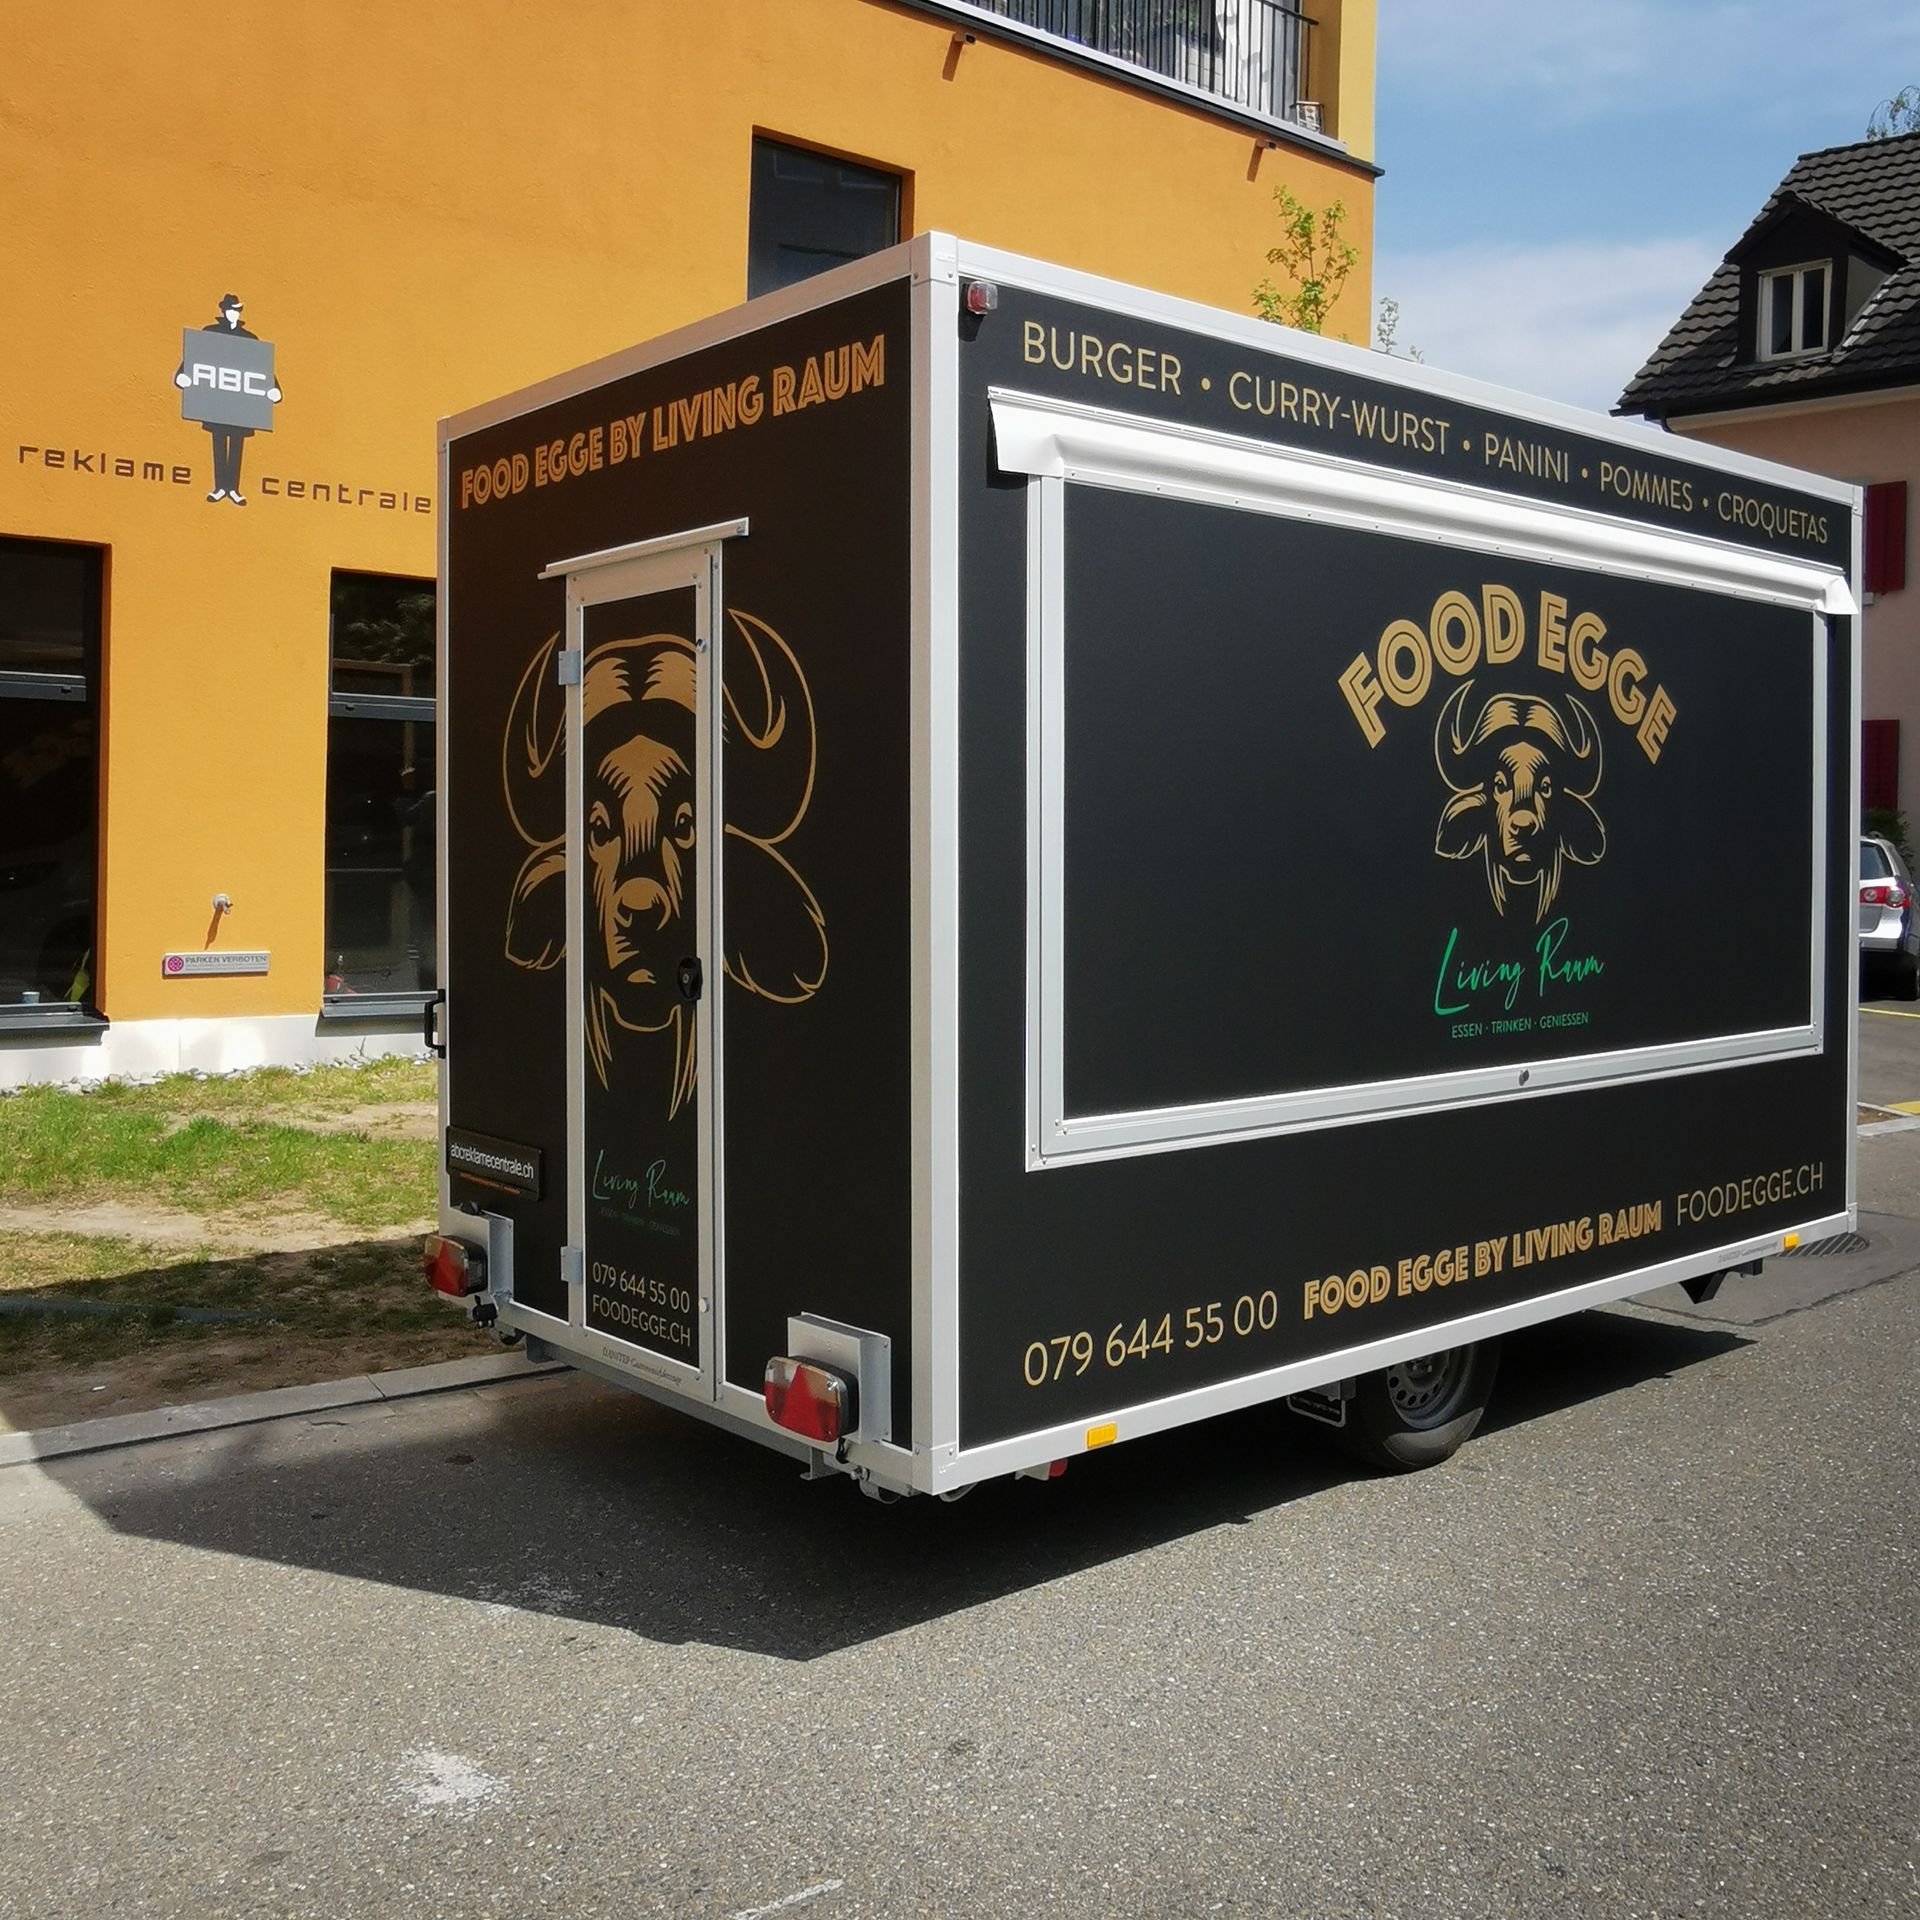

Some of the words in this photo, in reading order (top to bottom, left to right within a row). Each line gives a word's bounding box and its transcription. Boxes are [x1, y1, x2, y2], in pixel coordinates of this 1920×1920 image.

[193, 363, 267, 396] ABC
[462, 453, 530, 509] FOOD
[535, 426, 603, 487] EGGE
[609, 411, 646, 465] BY
[653, 375, 763, 452] LIVING
[772, 334, 885, 416] RAUM
[1023, 320, 1183, 395] BURGER
[1229, 371, 1450, 455] CURRY-WURST
[1485, 433, 1569, 483] PANINI
[1600, 461, 1694, 512] POMMES
[1718, 492, 1828, 544] CROQUETAS
[19, 445, 191, 485] reklame
[262, 476, 431, 514] centrale
[1338, 584, 1526, 749] FOOD
[1538, 590, 1677, 765] EGGE
[185, 956, 220, 964] PARKEN
[221, 955, 267, 963] VERBOTEN
[1435, 927, 1525, 1015] Living
[1536, 917, 1604, 997] Raum
[1452, 1022, 1483, 1039] ESSEN
[1491, 1017, 1532, 1034] TRINKEN
[1539, 1012, 1589, 1029] GENIESSEN
[592, 1148, 639, 1209] Living
[1676, 1161, 1824, 1227] FOODEGGE.CH
[592, 1262, 617, 1288] 079
[619, 1270, 646, 1299] 644
[649, 1279, 666, 1307] 55
[670, 1287, 690, 1314] 00
[1304, 1265, 1391, 1320] FOOD
[1397, 1247, 1469, 1297] EGGE
[1474, 1236, 1508, 1278] BY
[1512, 1216, 1593, 1268] LIVING
[1599, 1200, 1662, 1246] RAUM
[592, 1294, 691, 1348] FOODEGGE.CH
[1024, 1331, 1094, 1387] 079
[1105, 1313, 1174, 1368] 644
[1185, 1302, 1224, 1349] 55
[1233, 1290, 1278, 1337] 00
